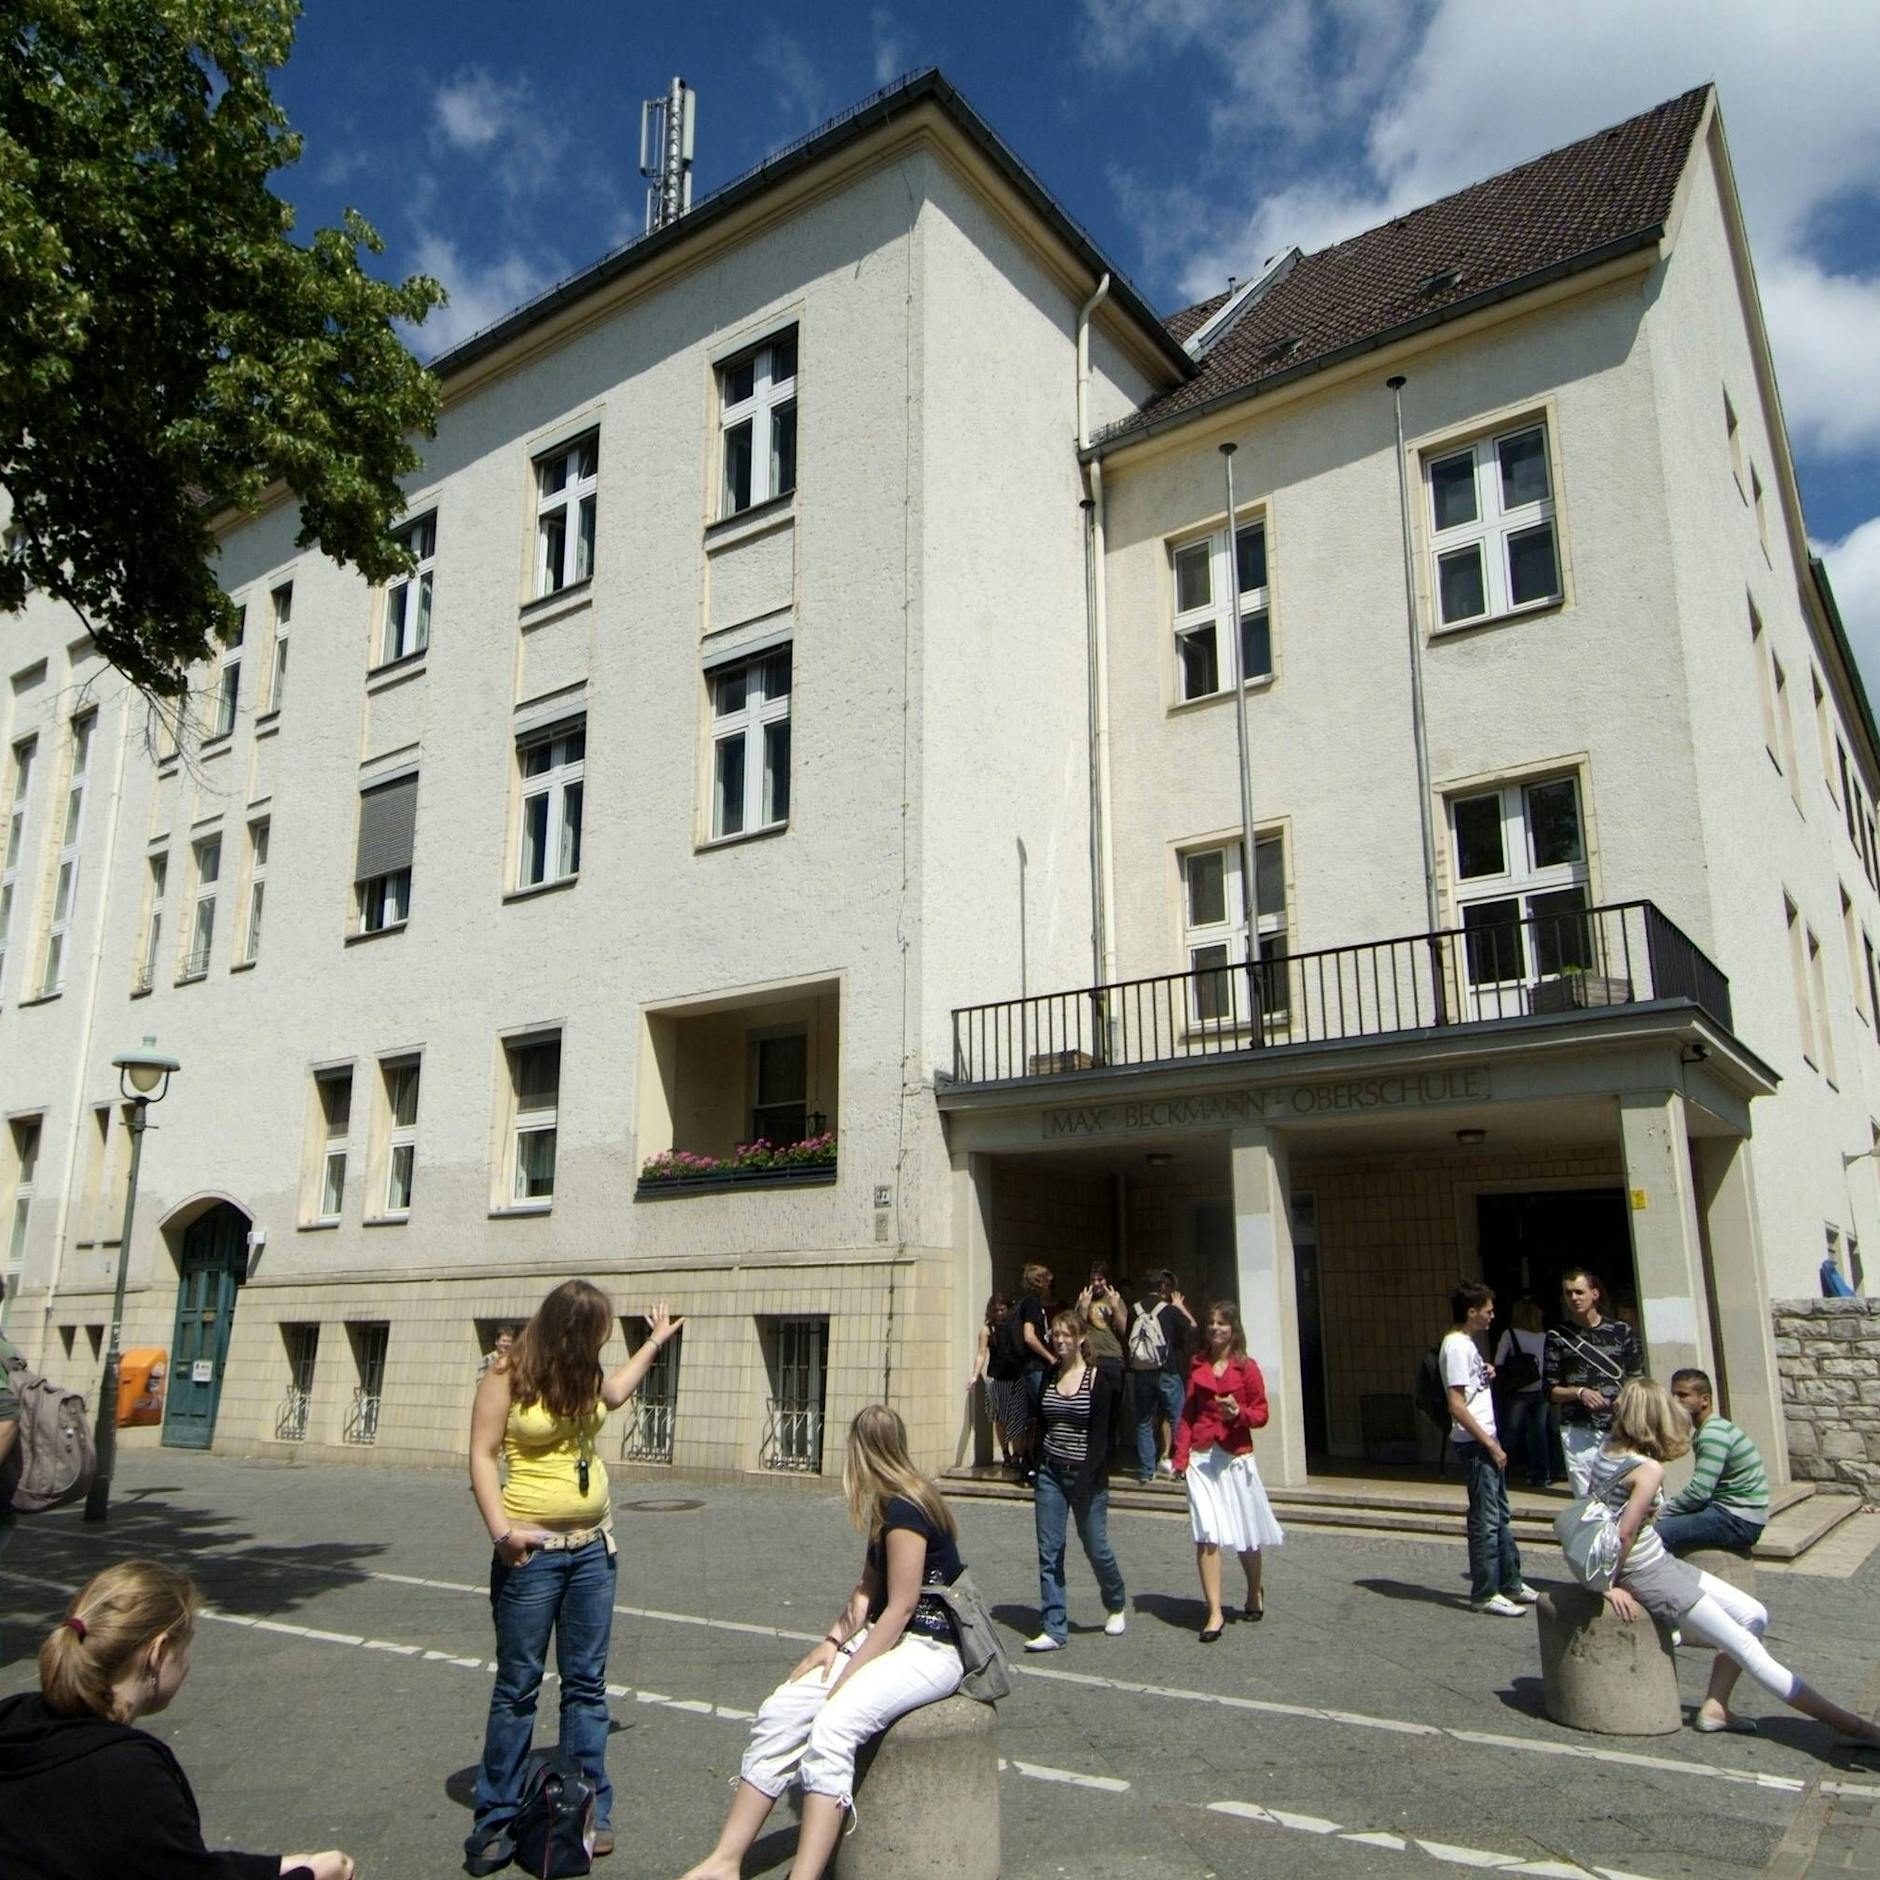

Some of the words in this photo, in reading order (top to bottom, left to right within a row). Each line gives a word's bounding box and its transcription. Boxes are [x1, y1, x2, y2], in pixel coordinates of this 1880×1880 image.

[1051, 1106, 1103, 1134] MAX
[1124, 1091, 1266, 1128] BECKMANN
[1292, 1071, 1480, 1113] OBERSCHULE
